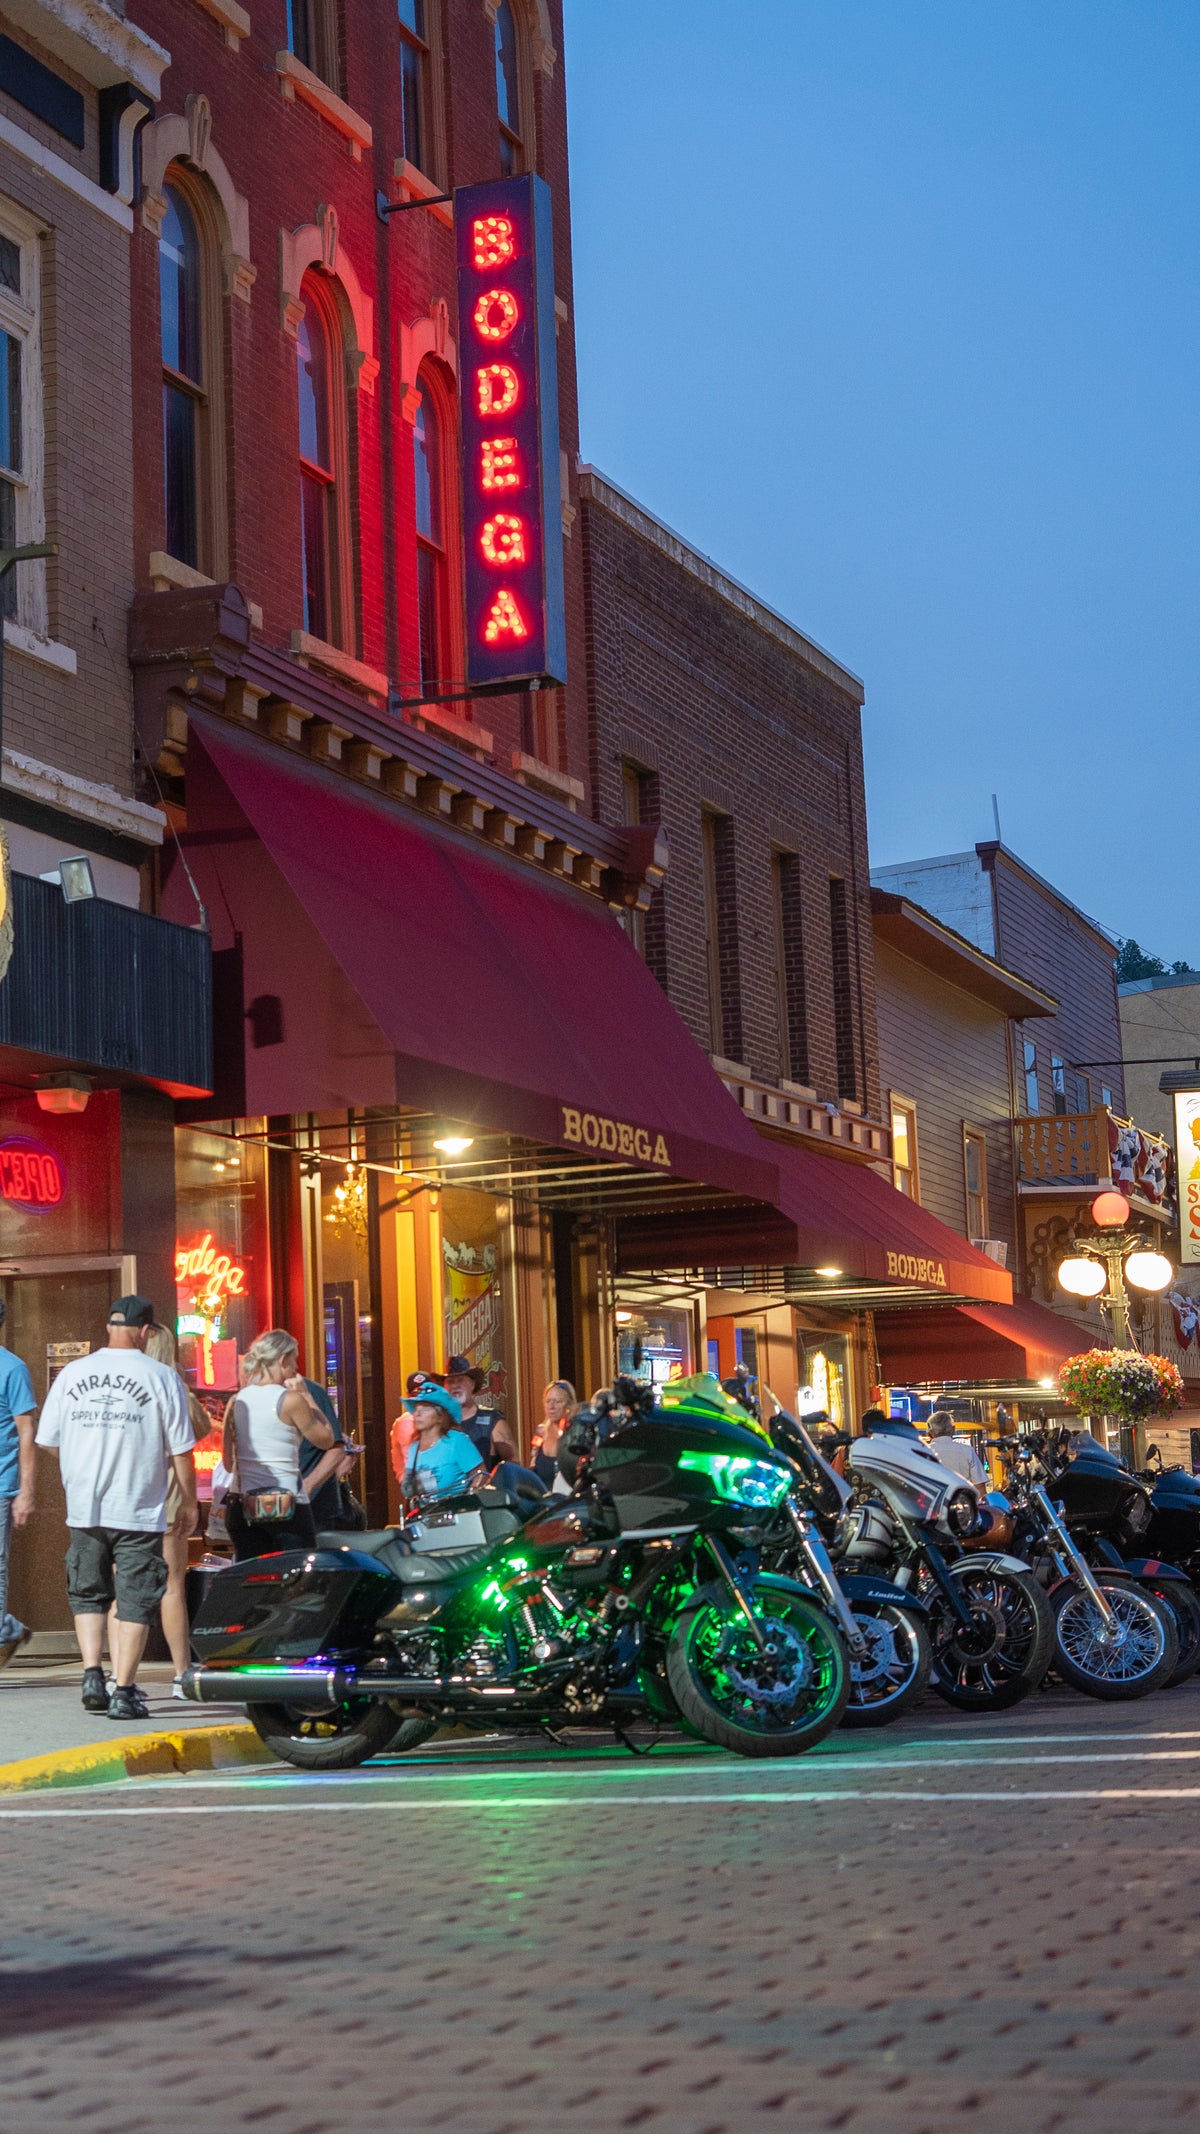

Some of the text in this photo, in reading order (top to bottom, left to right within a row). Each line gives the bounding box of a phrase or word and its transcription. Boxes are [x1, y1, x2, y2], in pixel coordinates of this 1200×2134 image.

[473, 216, 528, 642] BODEGA
[562, 1107, 671, 1166] BODEGA
[887, 1251, 947, 1286] BODEGA
[452, 1292, 491, 1357] BODEGA
[67, 1374, 152, 1407] THRASHIN
[102, 1411, 145, 1424] COMPANY
[868, 1590, 906, 1601] Limited
